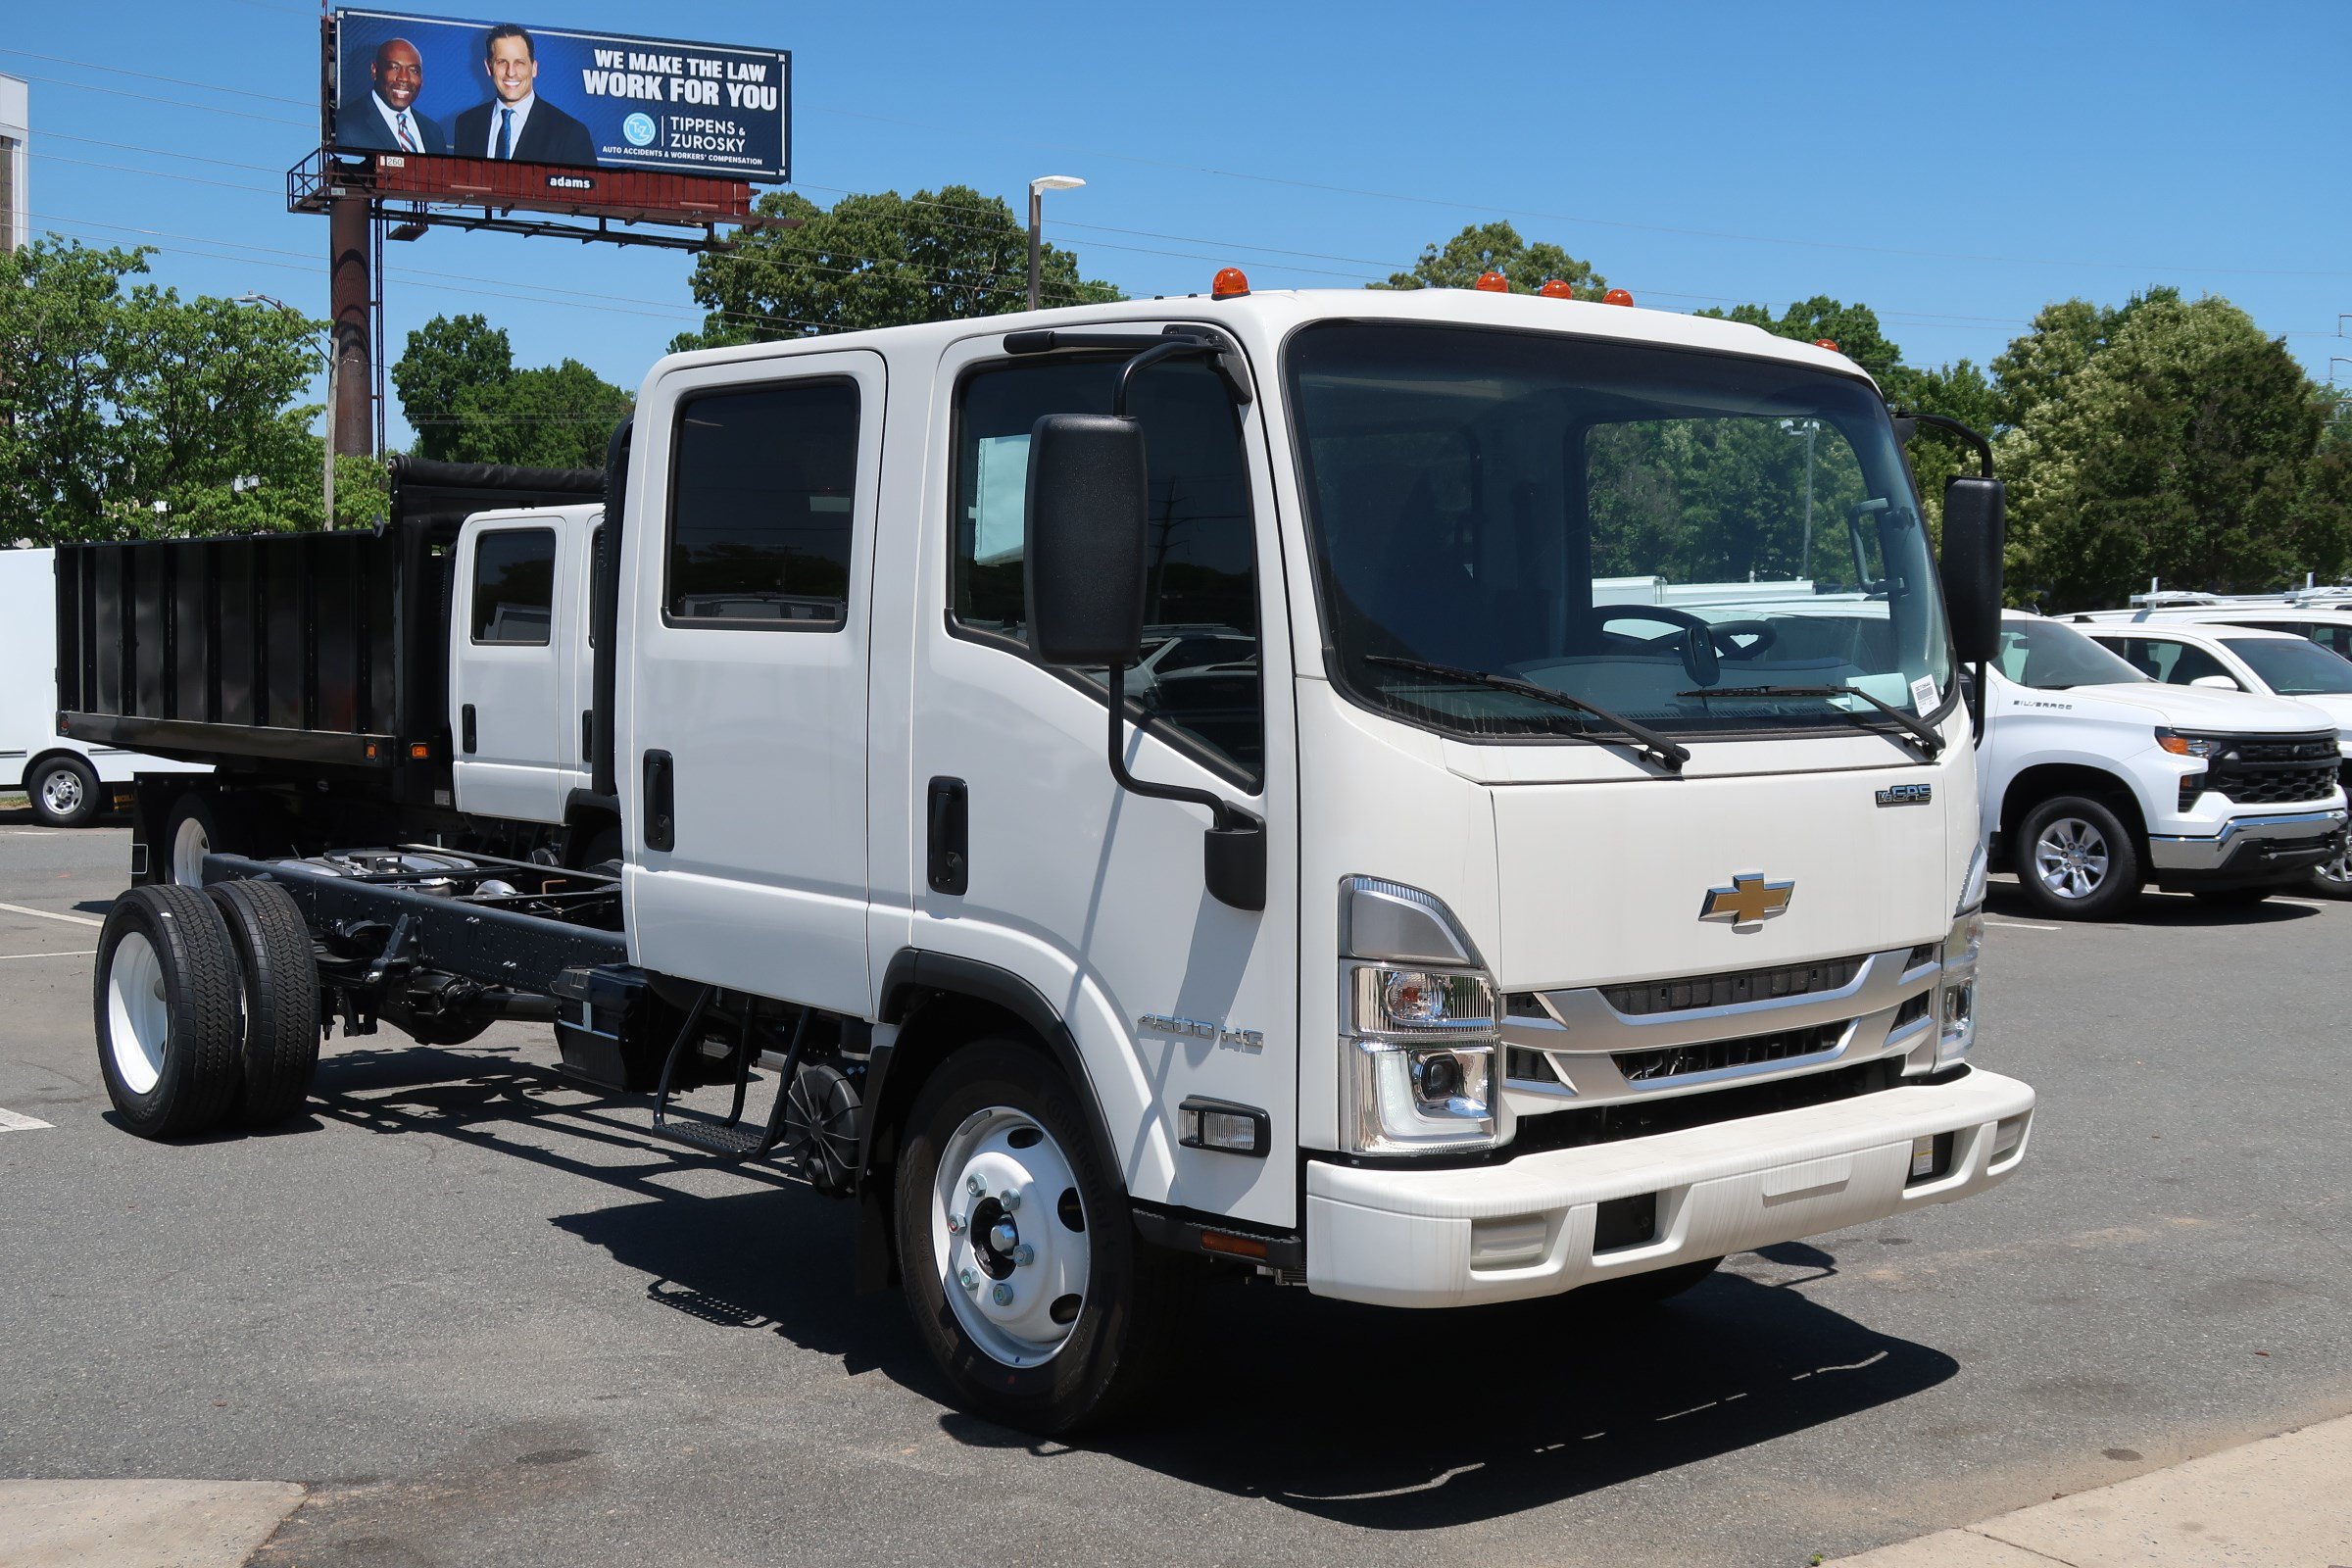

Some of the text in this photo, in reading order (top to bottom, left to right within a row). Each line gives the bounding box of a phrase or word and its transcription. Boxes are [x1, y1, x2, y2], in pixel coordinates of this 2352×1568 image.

[594, 49, 767, 82] WE MAKE THE LAW
[582, 69, 777, 111] WORK FOR YOU
[670, 116, 746, 136] TIPPENS &
[670, 133, 746, 153] ZUROSKY
[387, 157, 403, 167] 260
[602, 145, 622, 154] AUTO
[623, 147, 663, 157] ACCIDENTS
[670, 151, 707, 161] WORKERS'
[708, 154, 763, 166] COMPENSATION
[550, 176, 591, 189] adams
[1137, 1013, 1215, 1041] 4500
